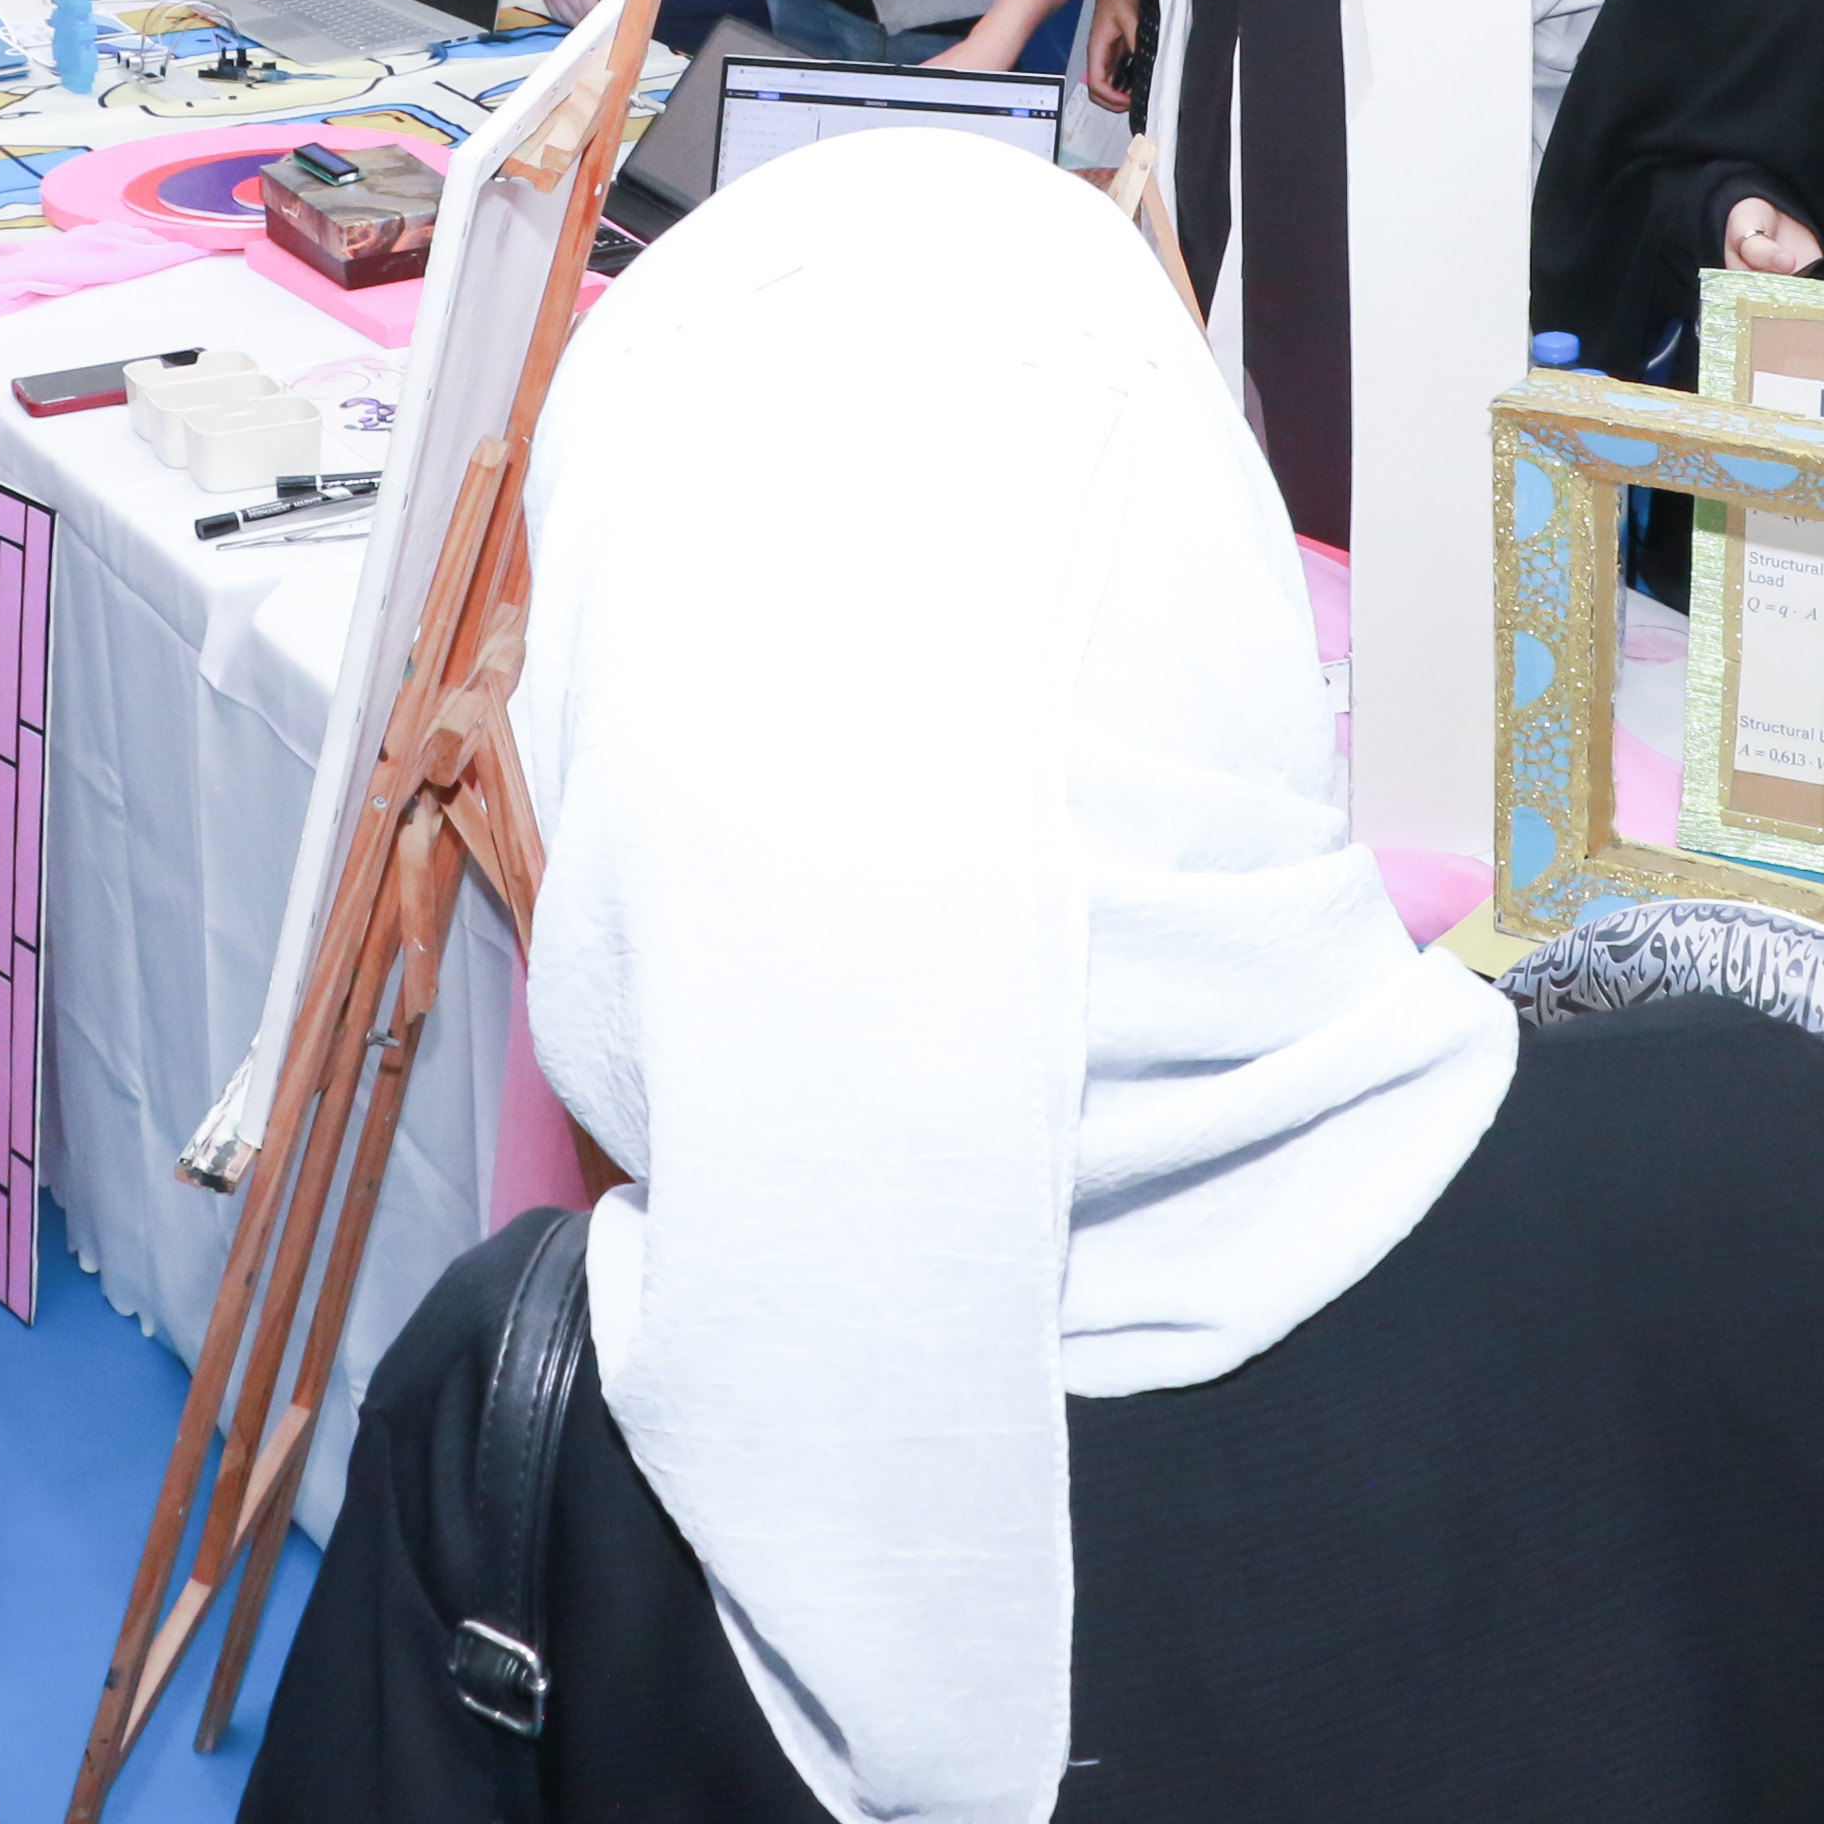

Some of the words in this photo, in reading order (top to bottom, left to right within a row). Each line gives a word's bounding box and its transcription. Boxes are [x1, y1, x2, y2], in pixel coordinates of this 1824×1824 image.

[1748, 551, 1824, 576] Structural
[1748, 570, 1784, 588] Load
[1739, 715, 1815, 741] Structural
